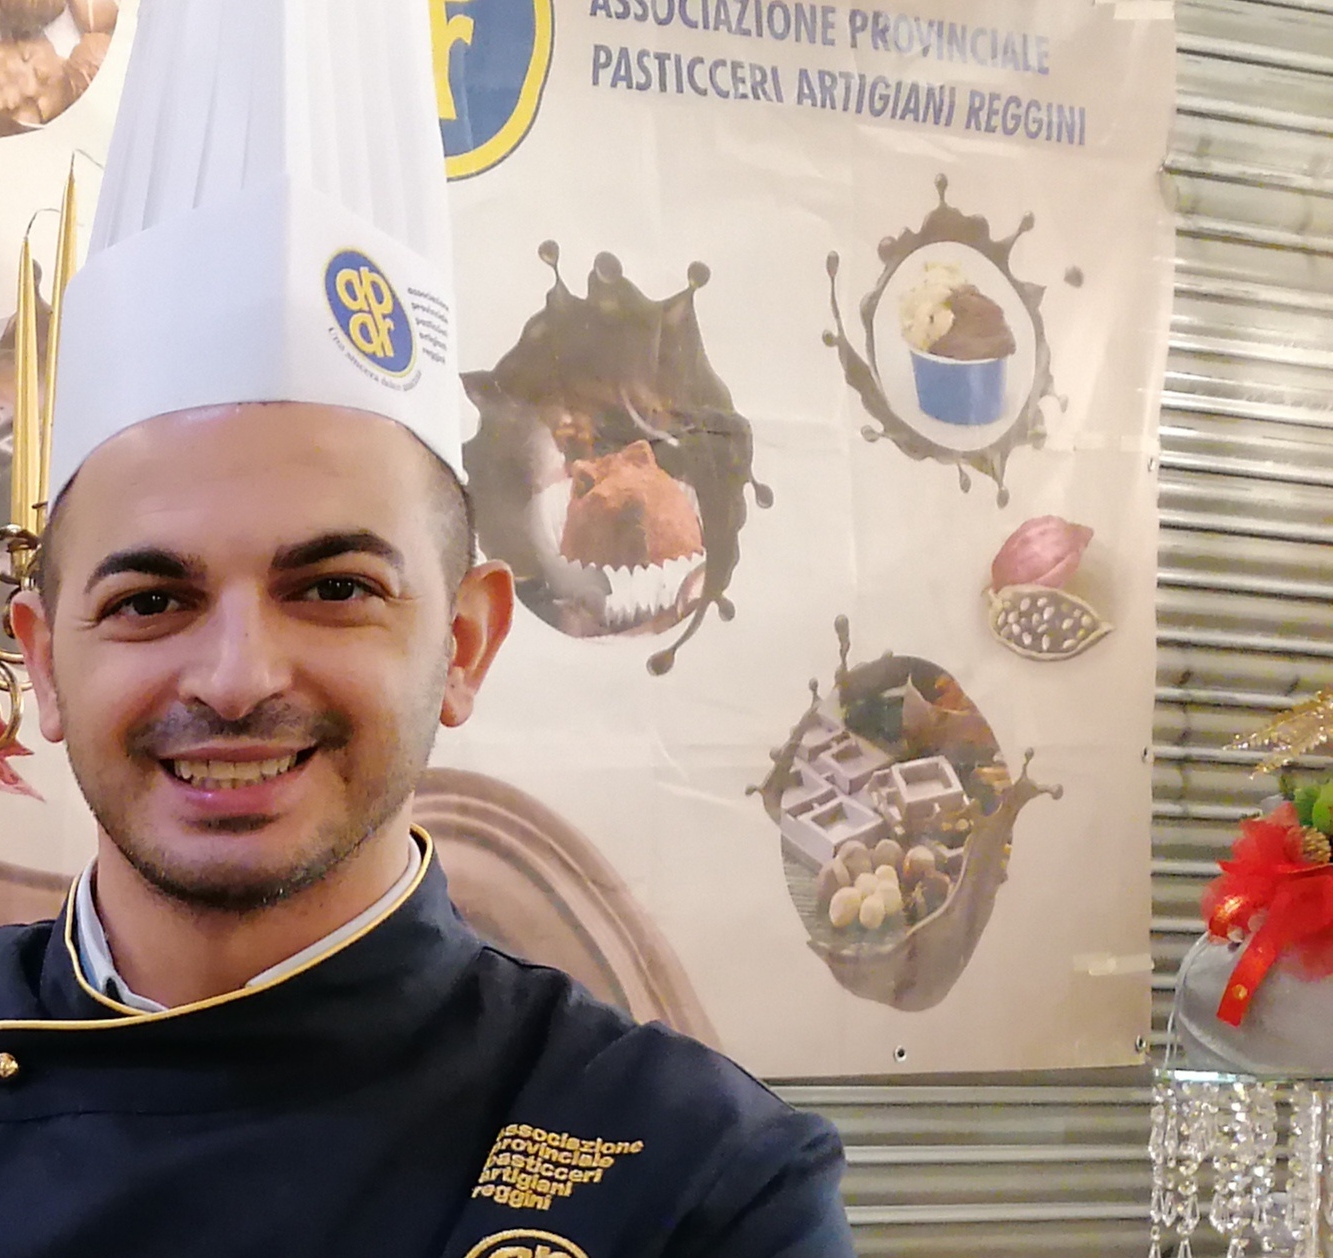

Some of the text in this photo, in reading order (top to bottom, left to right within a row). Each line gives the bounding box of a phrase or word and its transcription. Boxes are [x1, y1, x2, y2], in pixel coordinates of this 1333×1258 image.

[848, 8, 1050, 75] PROVINCIALE
[591, 43, 1086, 146] PASTICCERI ARTIGIANI REGGINI
[471, 1184, 553, 1211] reggini
